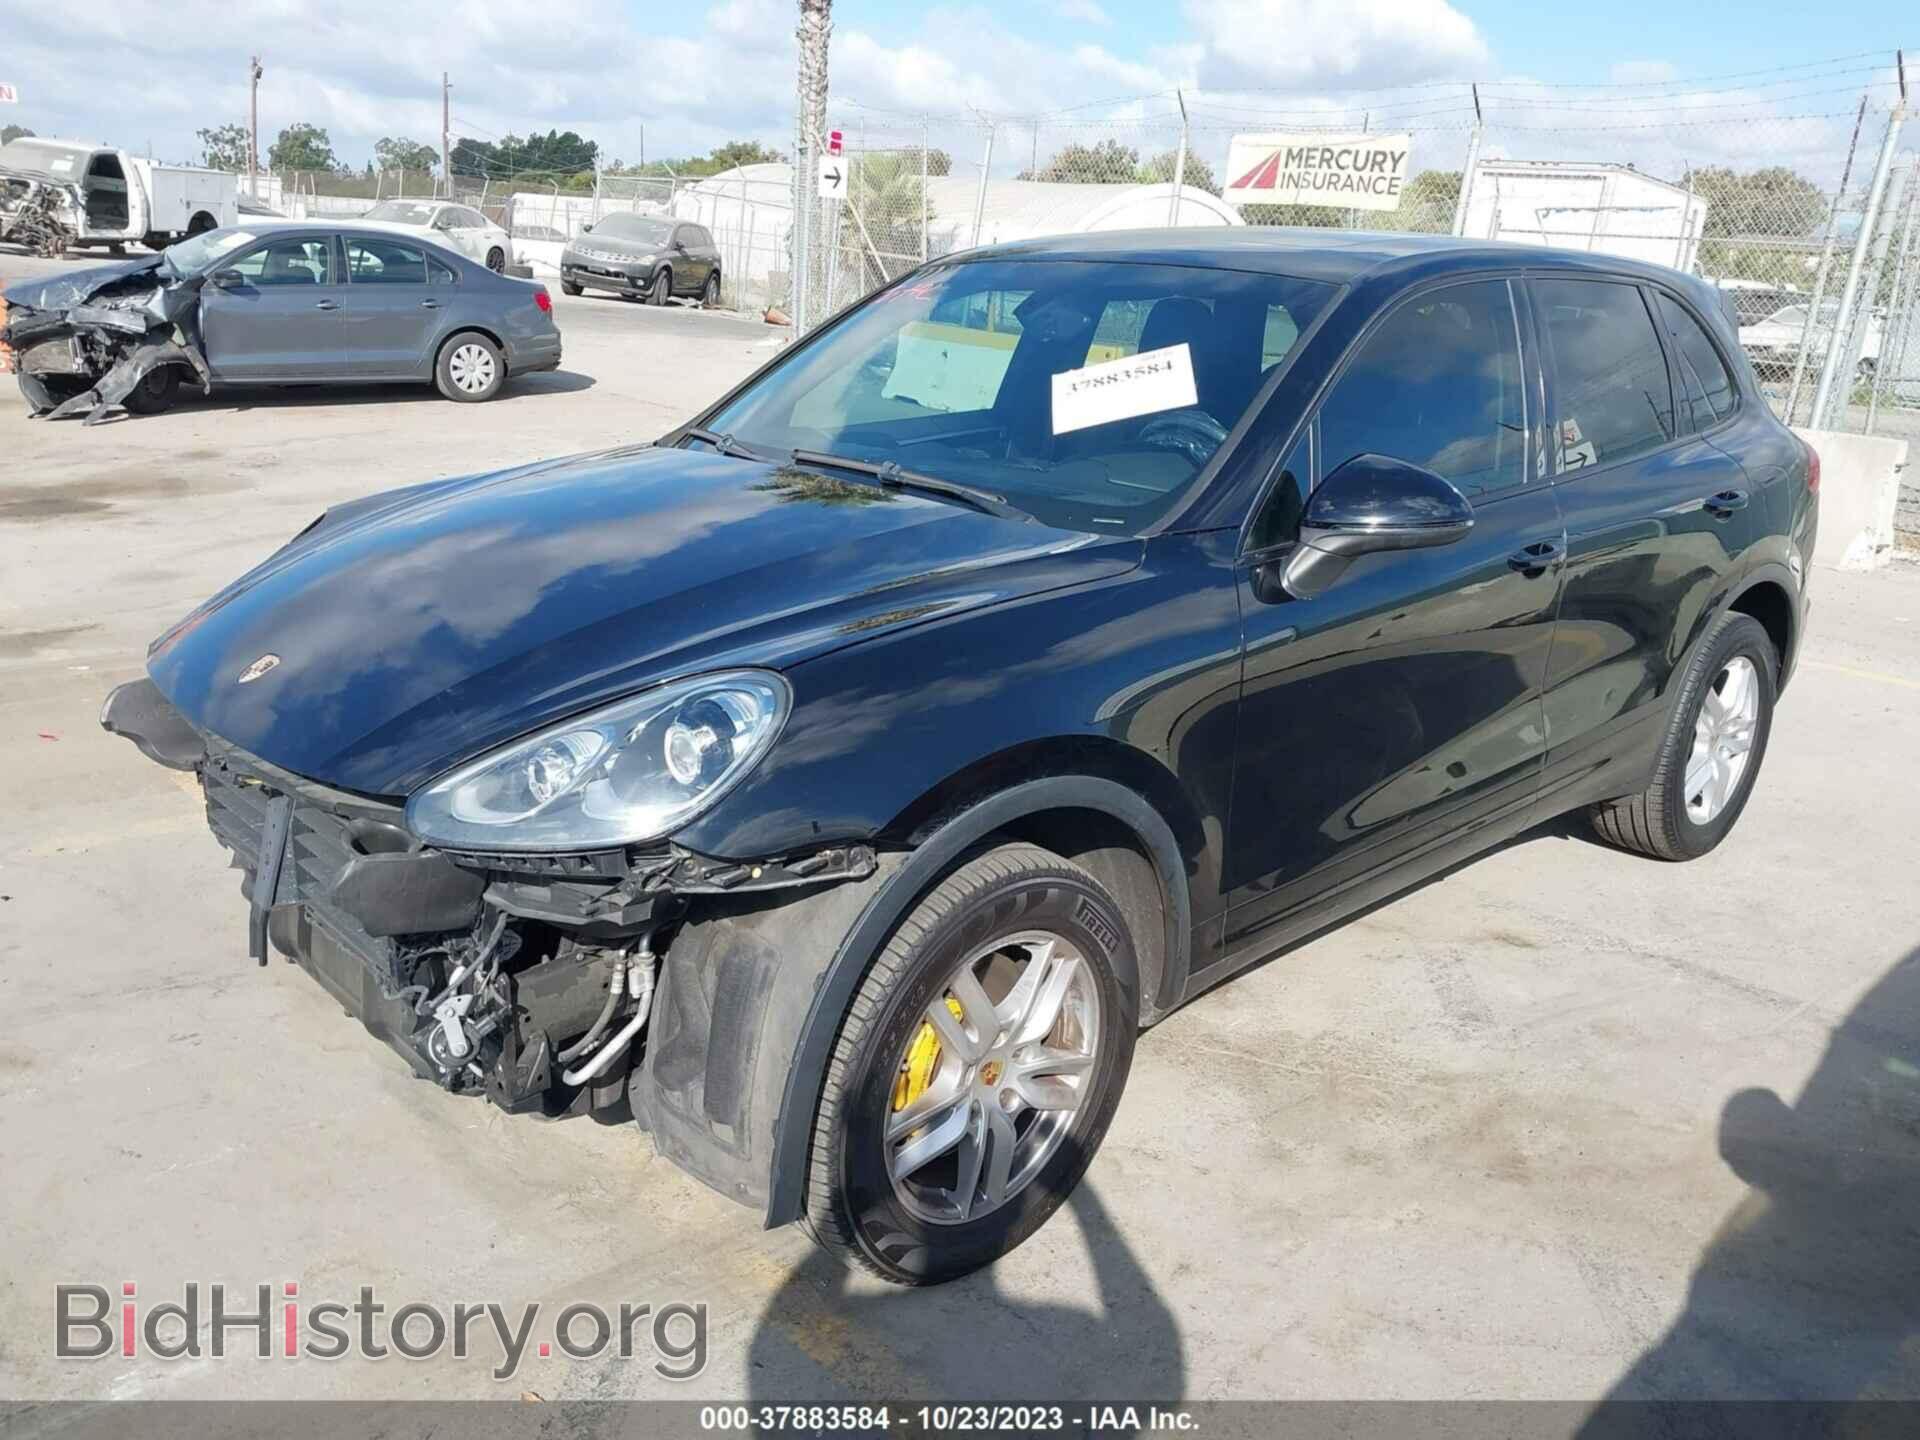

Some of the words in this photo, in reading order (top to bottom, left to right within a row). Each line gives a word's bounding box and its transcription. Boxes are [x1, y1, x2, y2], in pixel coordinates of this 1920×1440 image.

[1284, 147, 1407, 174] MERCURY
[1280, 171, 1402, 196] INSURANCE
[1076, 898, 1120, 953] PIRELLI
